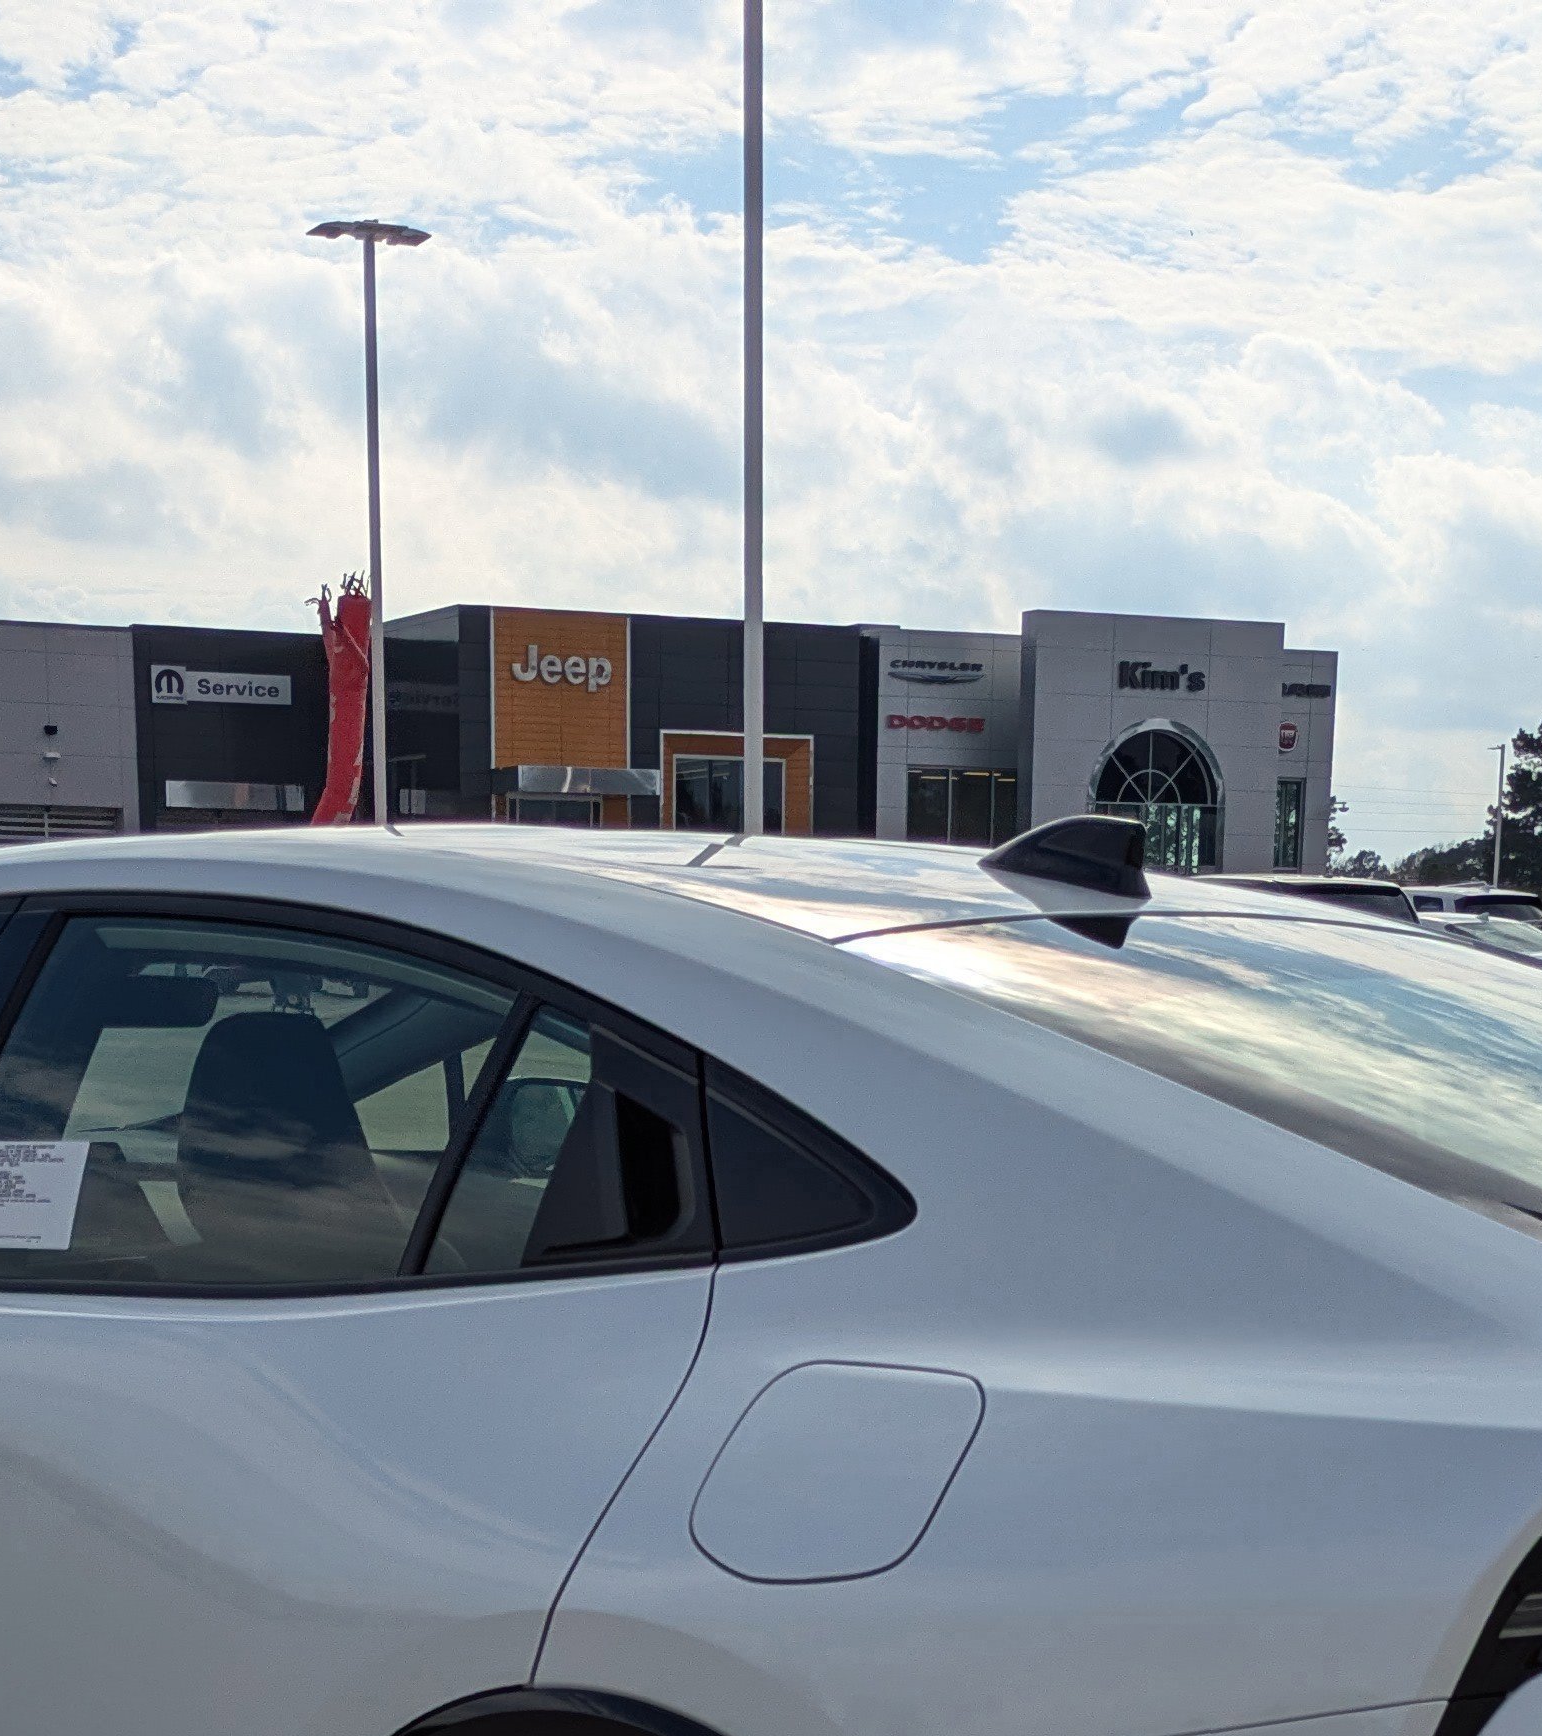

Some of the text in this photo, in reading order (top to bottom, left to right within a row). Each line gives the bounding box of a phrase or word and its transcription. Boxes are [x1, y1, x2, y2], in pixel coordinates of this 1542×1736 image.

[512, 644, 612, 692] Jeep
[889, 660, 984, 672] CHRYSLER
[1118, 661, 1206, 692] Kim's
[197, 679, 280, 698] Service
[886, 714, 985, 733] DODGE
